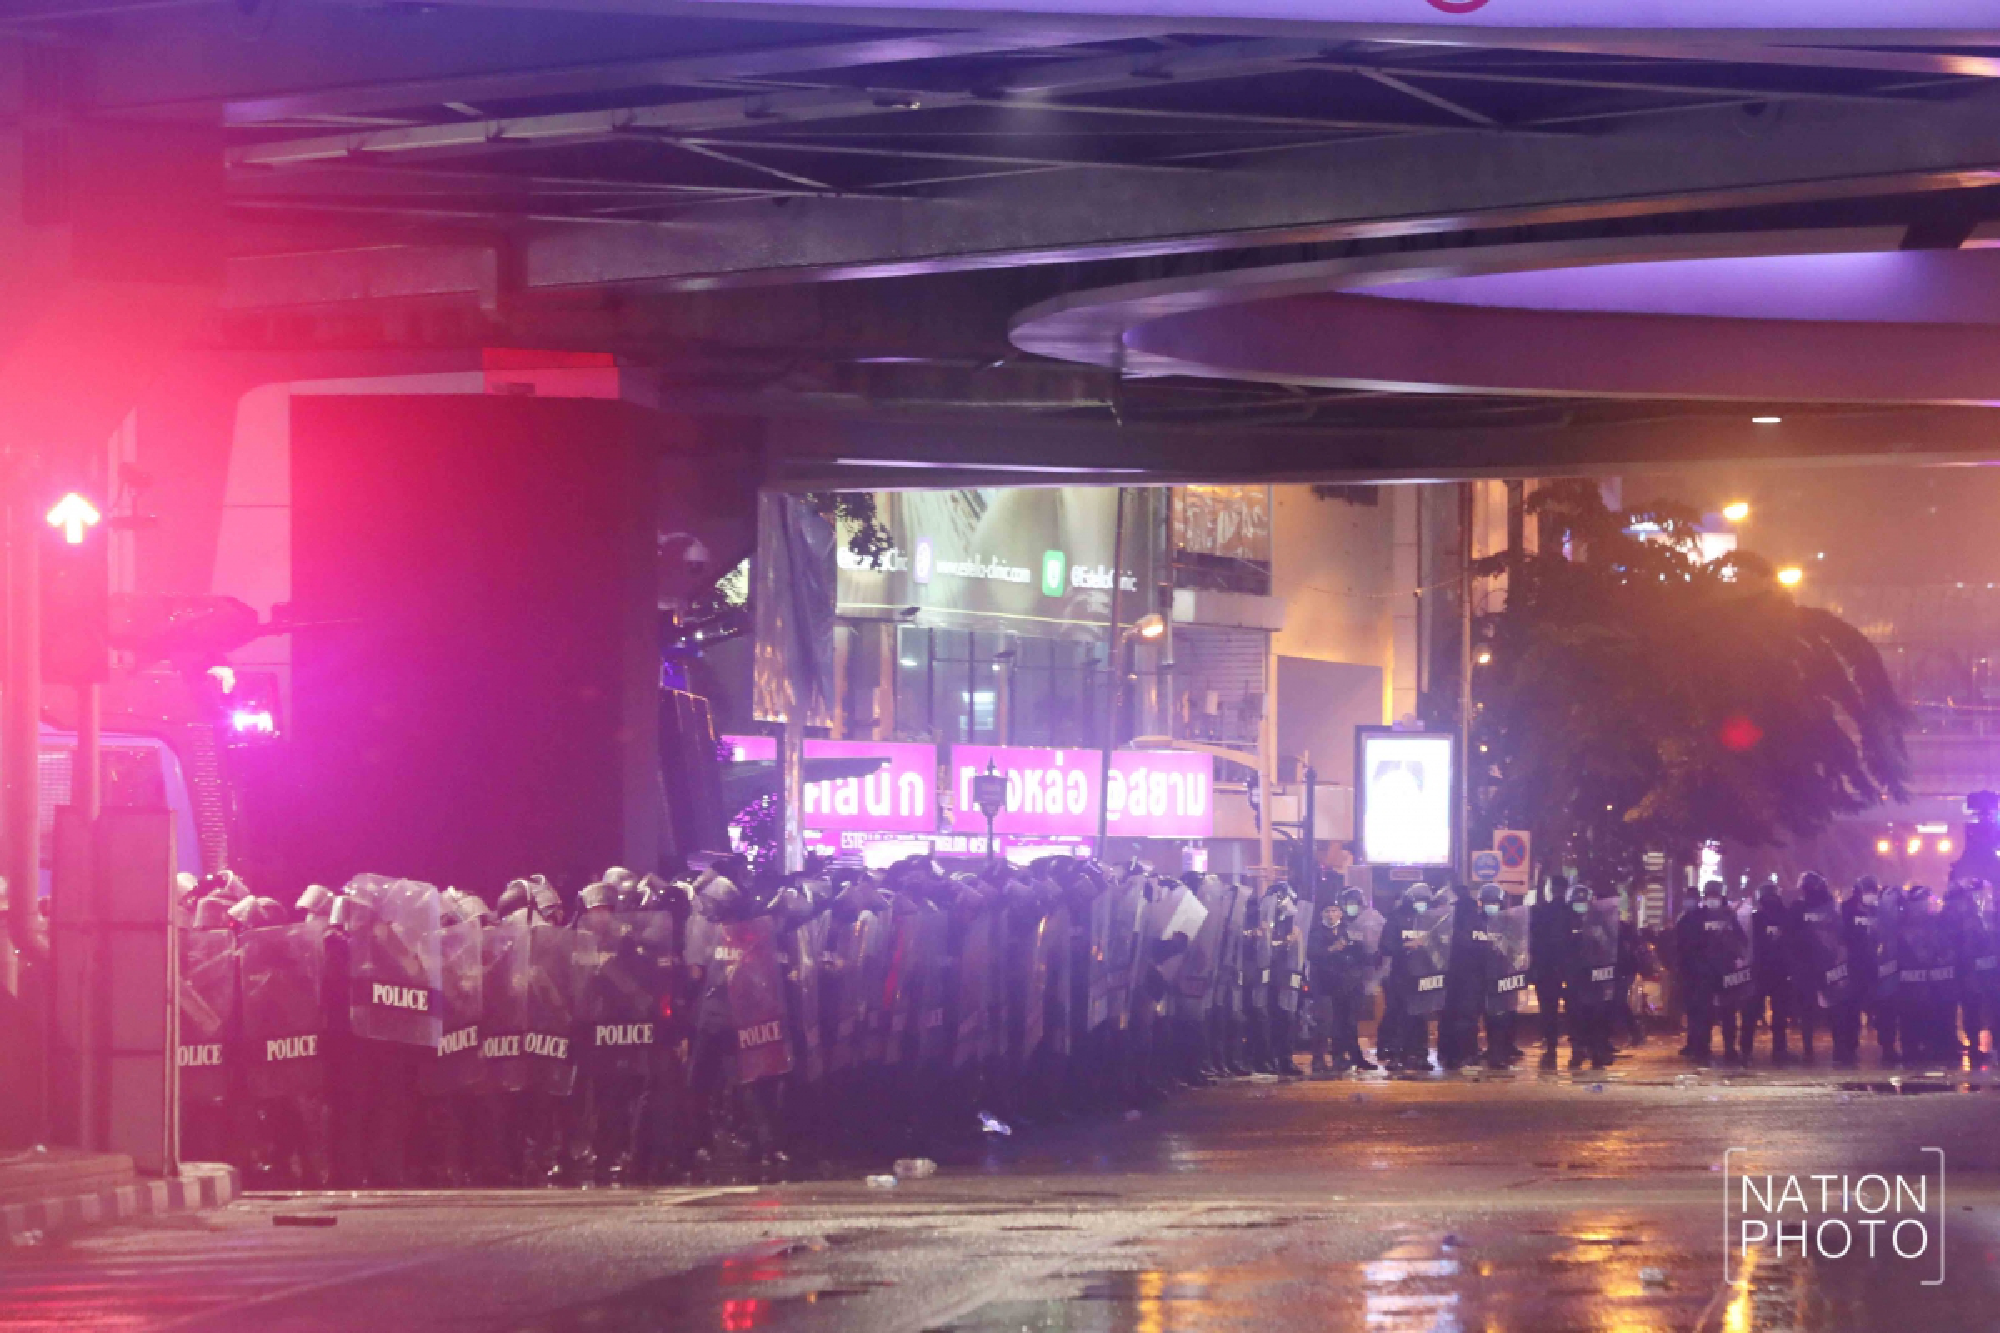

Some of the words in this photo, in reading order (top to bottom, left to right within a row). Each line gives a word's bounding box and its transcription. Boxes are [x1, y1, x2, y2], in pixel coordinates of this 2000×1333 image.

[960, 750, 1088, 816] ทงหล่อ
[372, 983, 428, 1011] POLICE
[267, 1035, 317, 1061] POLICE
[437, 1025, 478, 1057] POLICE
[483, 1035, 521, 1058] OLICE
[525, 1032, 569, 1059] OLICE
[596, 1023, 653, 1046] POLICE
[738, 1021, 782, 1049] POLICE
[177, 1043, 222, 1067] OLICE
